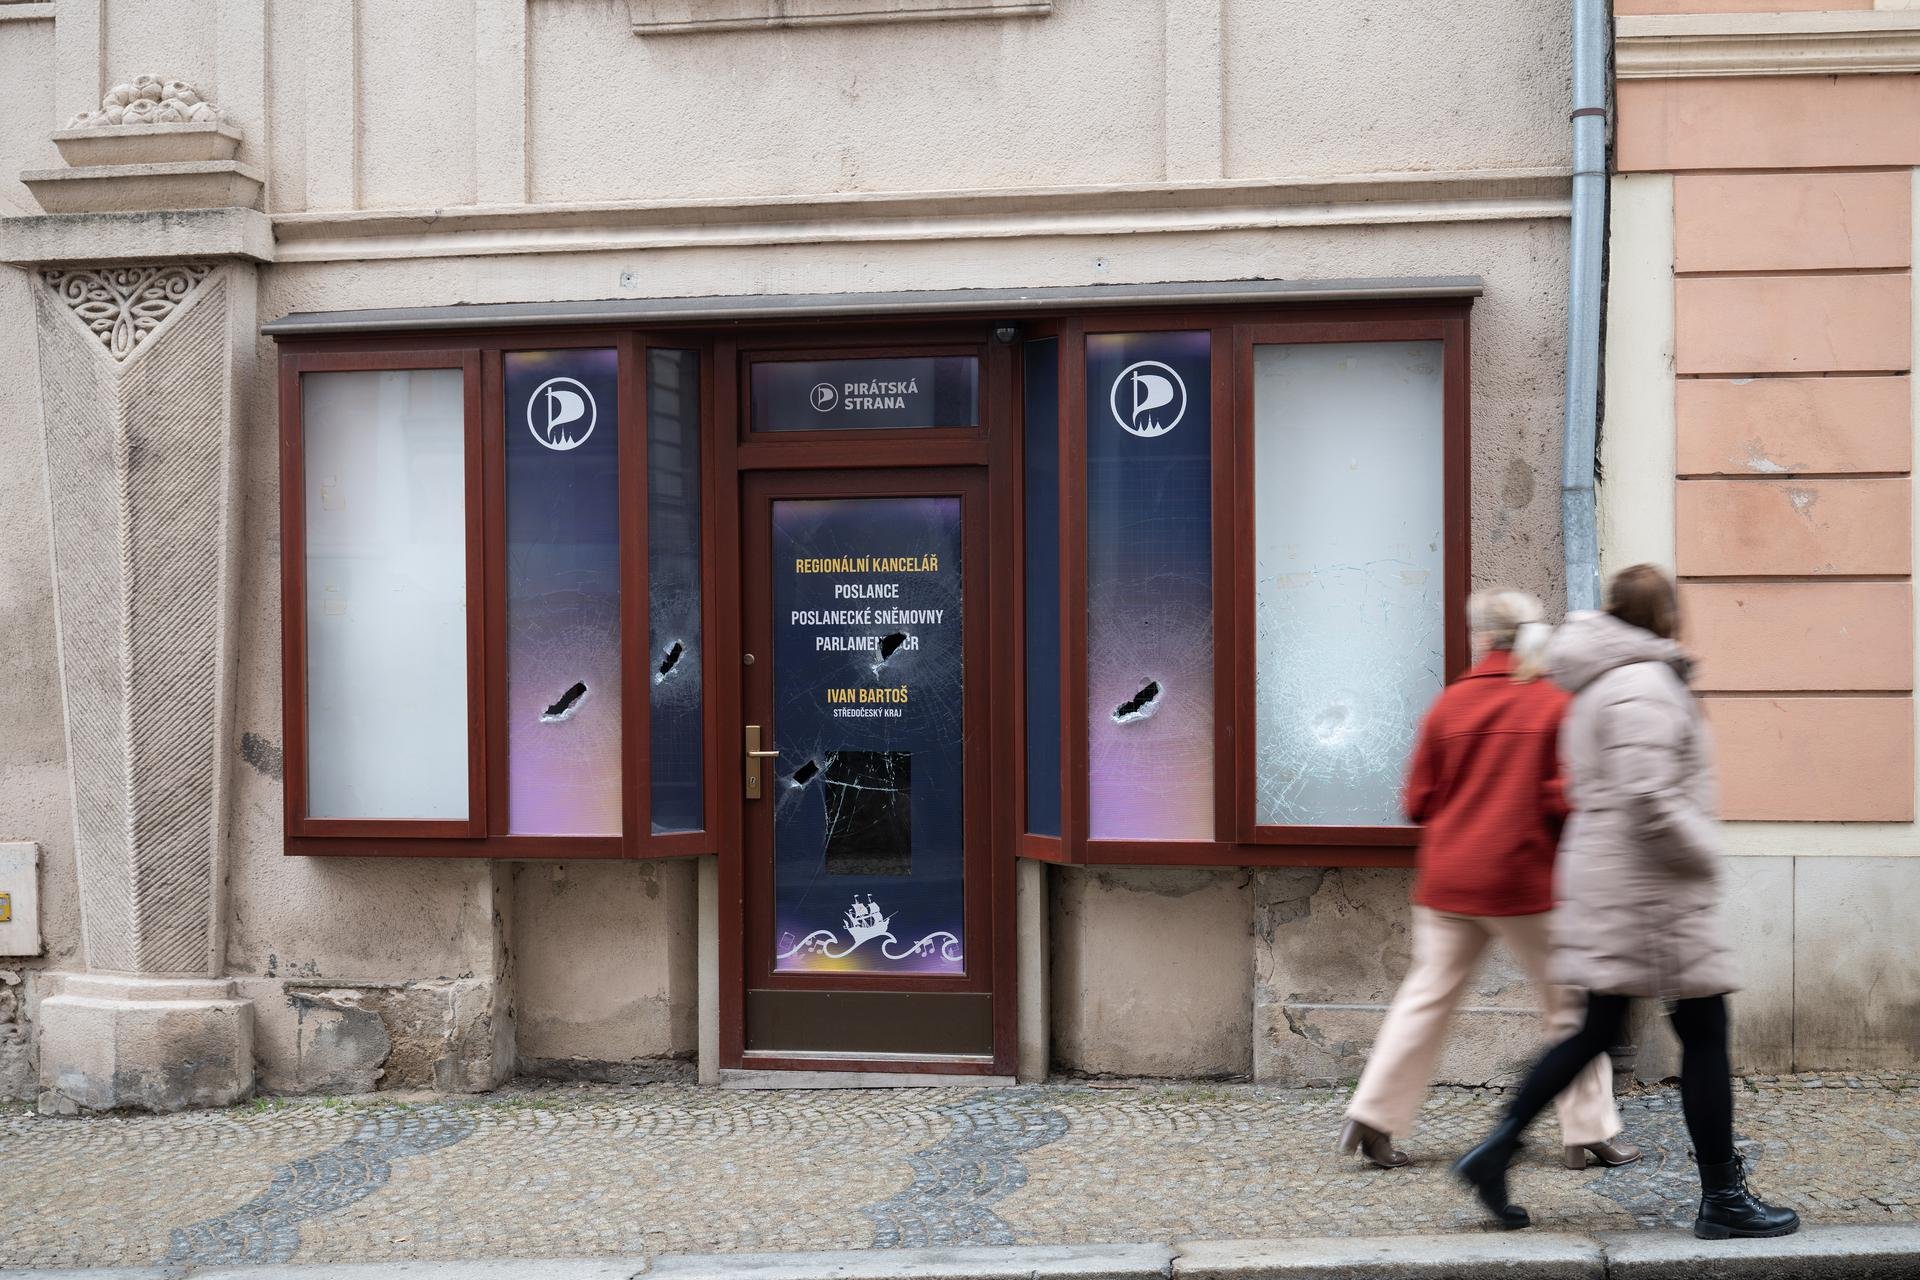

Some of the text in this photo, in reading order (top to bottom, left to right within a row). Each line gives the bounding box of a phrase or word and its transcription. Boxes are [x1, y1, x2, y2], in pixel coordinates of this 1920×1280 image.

[844, 378, 918, 395] PIRÁTSKÁ
[844, 397, 905, 410] STRANA
[796, 554, 938, 573] REGIONÁLNÍ KANCELÁŘ
[835, 584, 899, 599] POSLANCE
[791, 607, 944, 625] POSLANECKÉ SNĚMOVNY
[827, 685, 908, 703] IVAN BARTOŠ
[833, 706, 902, 718] STŘEDOČESKÝ KRAJ
